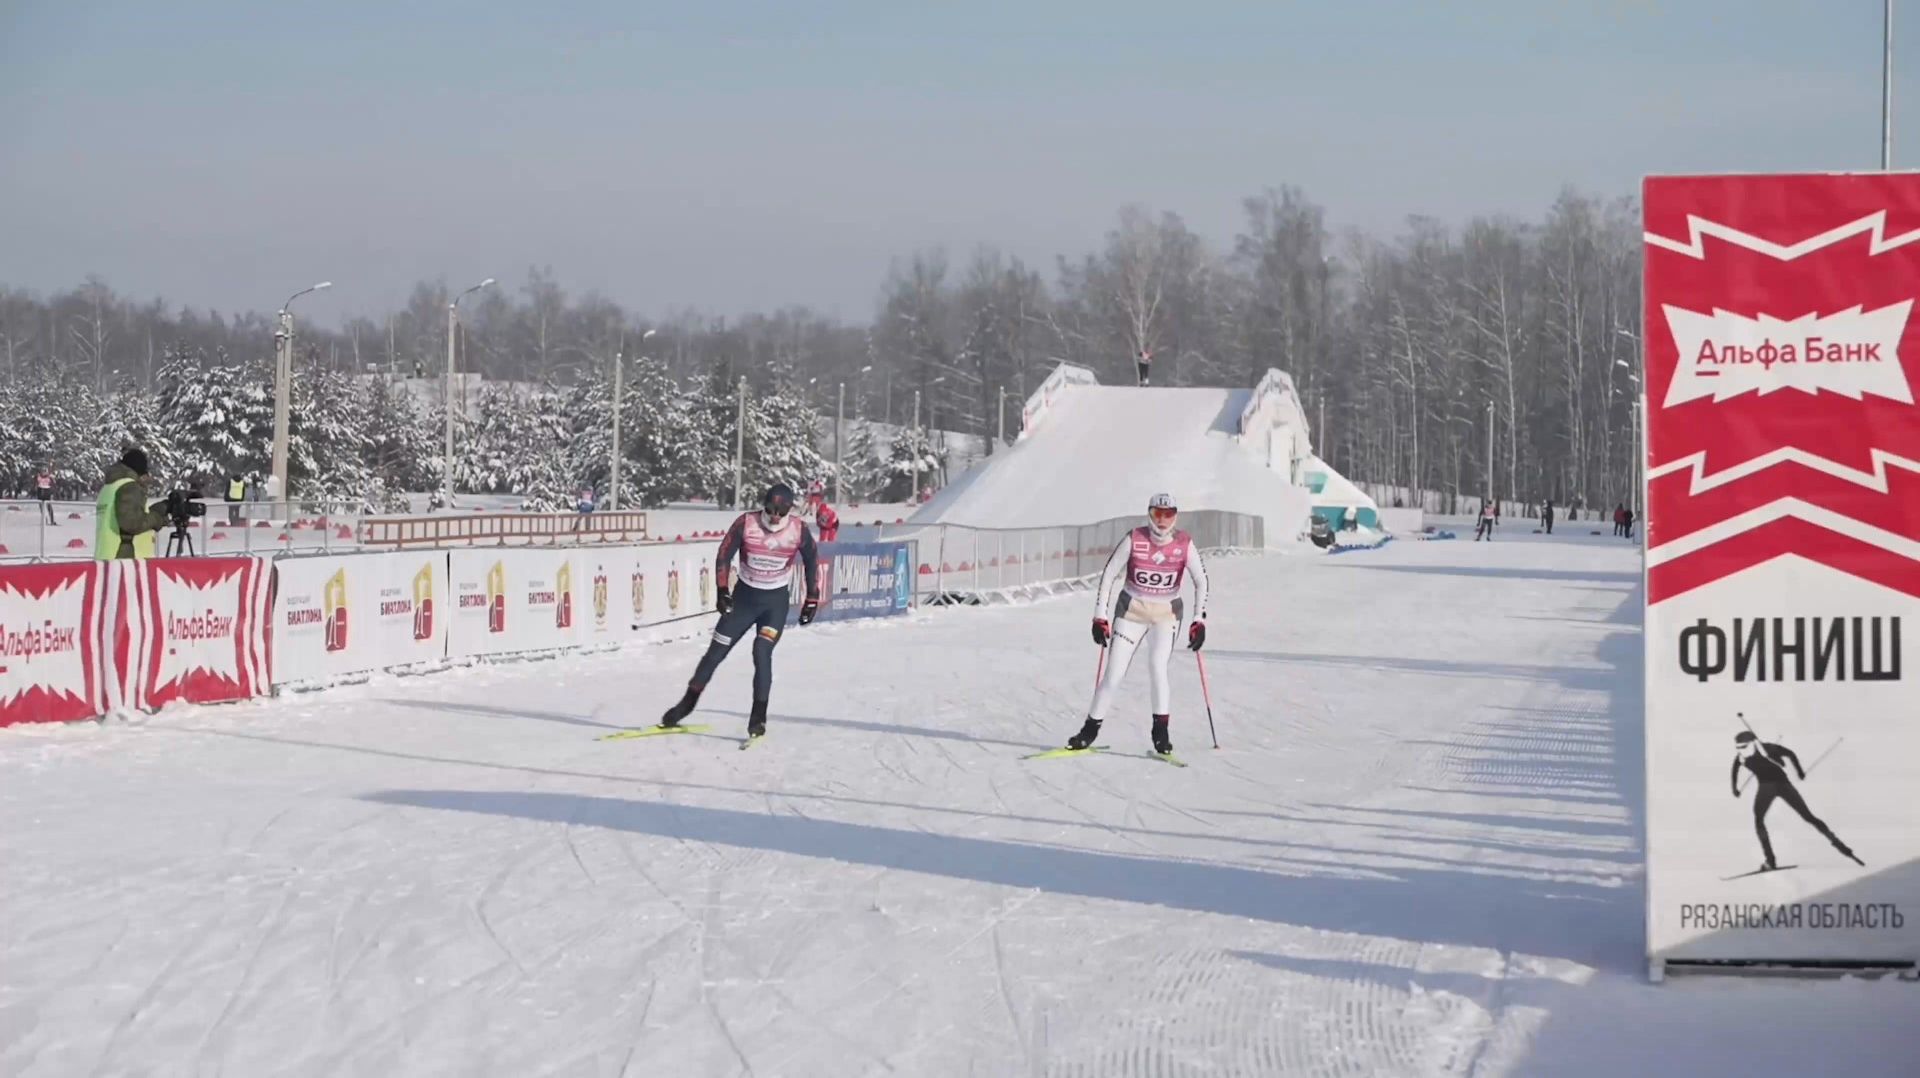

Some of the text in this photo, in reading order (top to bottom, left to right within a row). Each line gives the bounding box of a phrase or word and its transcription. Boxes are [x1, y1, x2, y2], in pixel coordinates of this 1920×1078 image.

[1696, 336, 1881, 371] Альфа Банк
[1135, 571, 1174, 587] 691
[43, 619, 74, 654] Банк
[168, 608, 232, 648] Альфа Банк
[1678, 616, 1902, 683] ФИНИШ
[1680, 903, 1905, 929] РЯЗАНСКАЯ ОБЛАСТЬ
